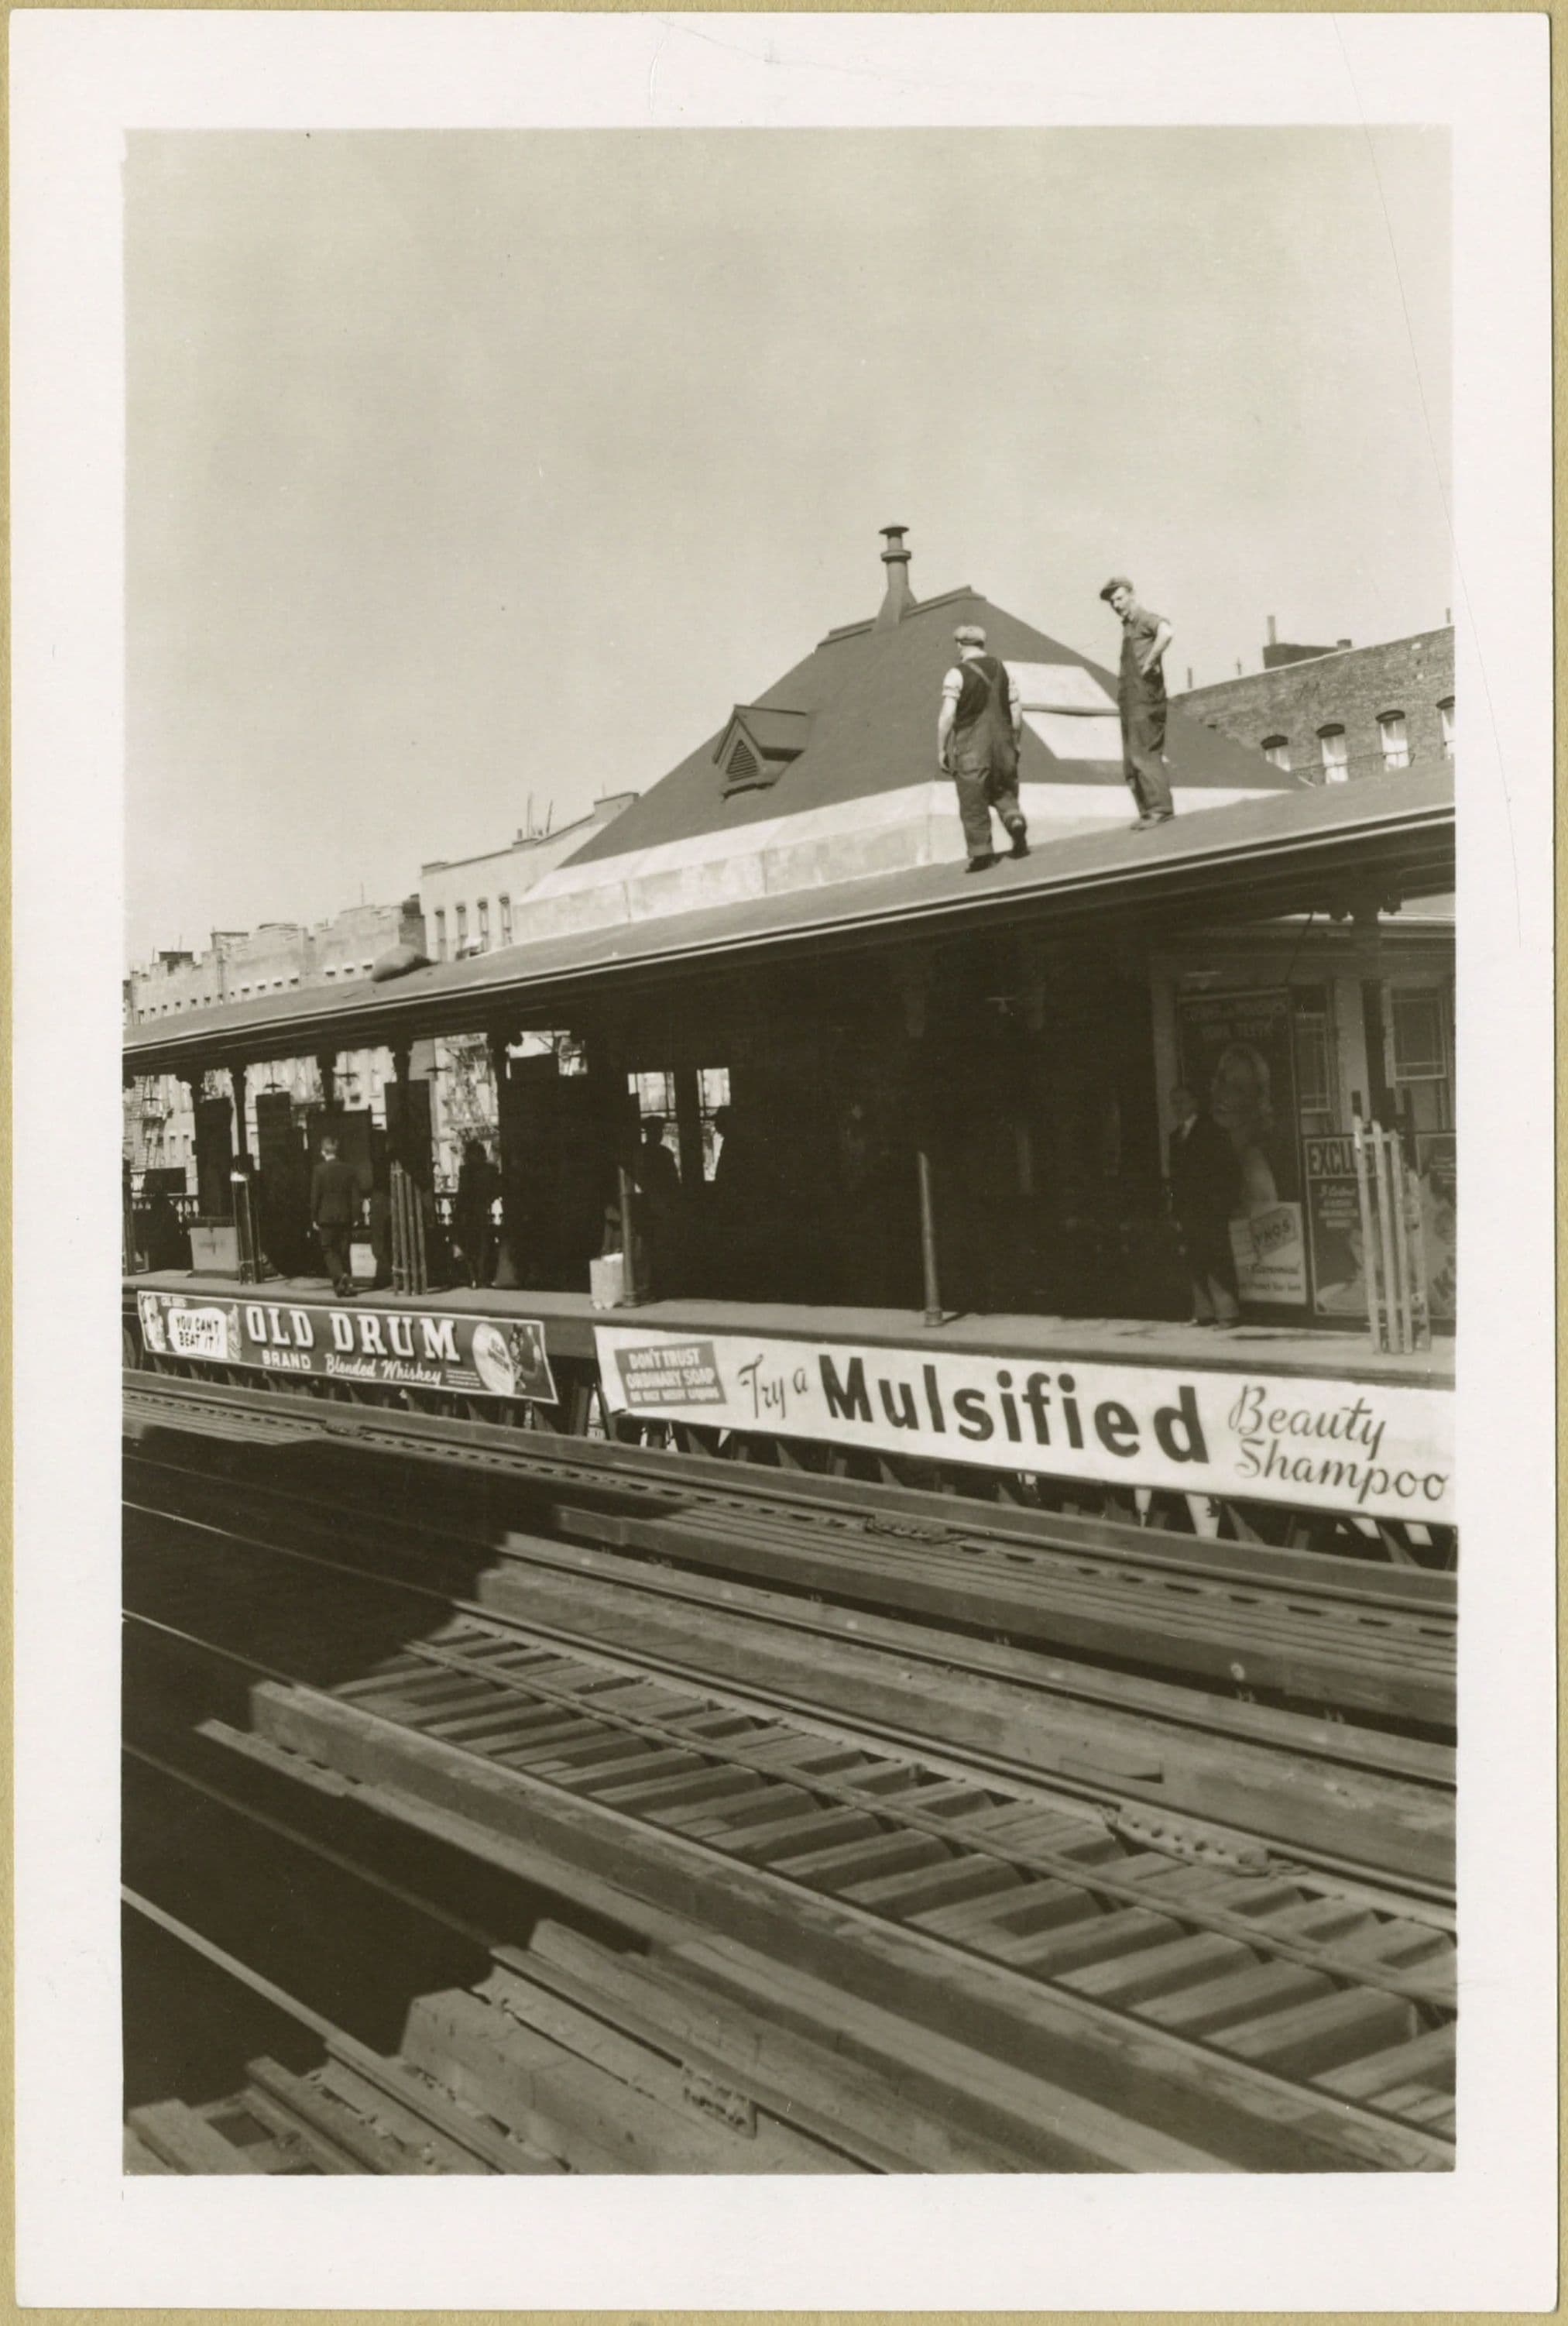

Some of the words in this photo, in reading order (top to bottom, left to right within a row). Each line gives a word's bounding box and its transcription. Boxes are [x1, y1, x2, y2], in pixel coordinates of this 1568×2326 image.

[176, 1315, 193, 1330] YOU
[246, 1305, 314, 1348] OLD
[330, 1311, 461, 1362] DRUM
[179, 1331, 201, 1348] BEAT
[262, 1349, 311, 1371] BRAND
[324, 1352, 377, 1379] Blended
[381, 1359, 442, 1386] Whiskey
[628, 1349, 661, 1370] DON'T
[662, 1347, 701, 1368] TRUST
[625, 1370, 682, 1389] ORDINARY
[682, 1367, 715, 1386] SOAP
[737, 1353, 787, 1420] Try
[793, 1367, 808, 1395] a
[818, 1354, 1210, 1465] Mulsified
[1227, 1383, 1387, 1461] Beauty
[1233, 1438, 1450, 1505] Shampoo
